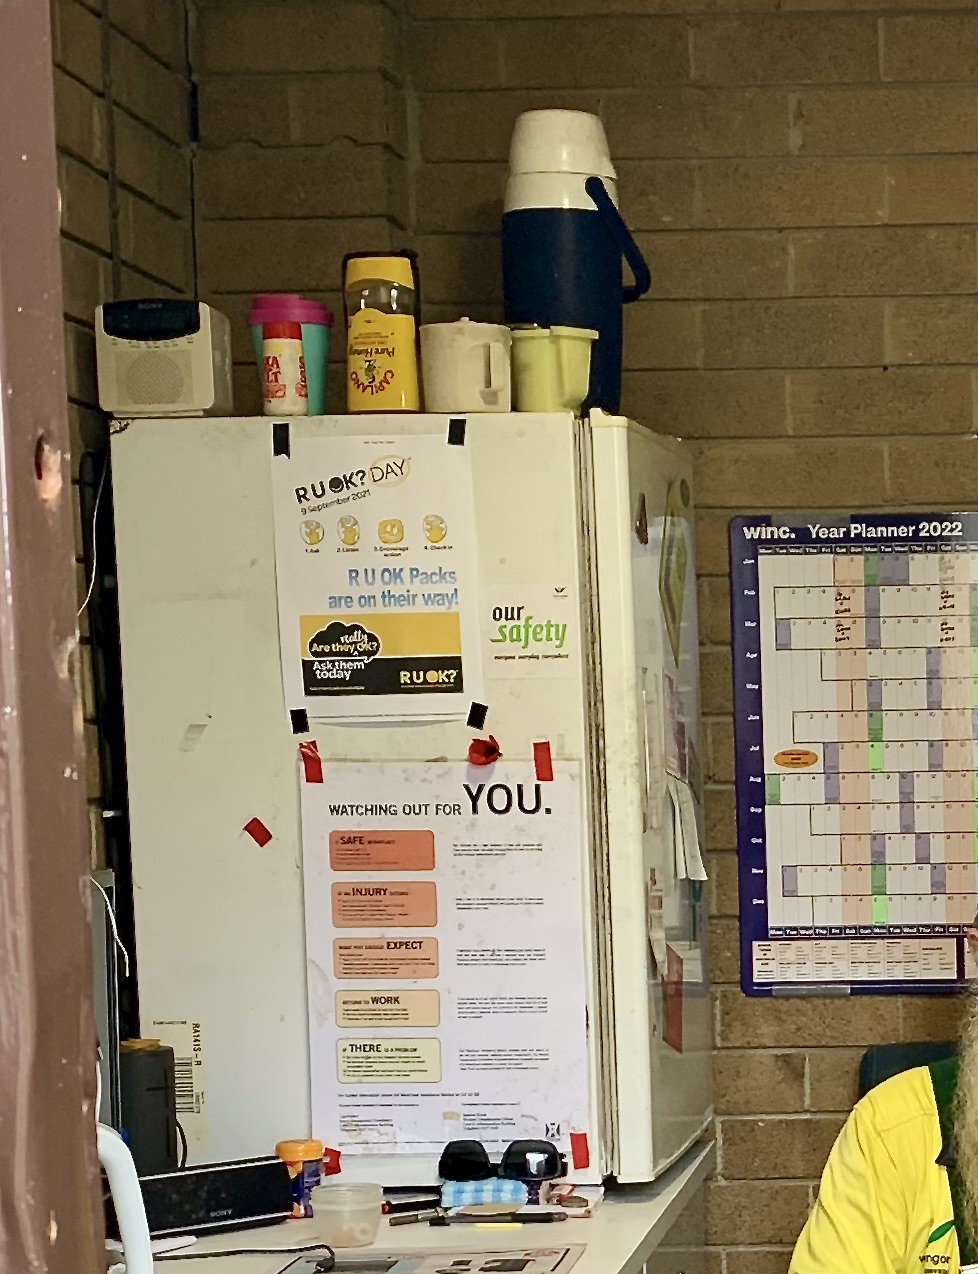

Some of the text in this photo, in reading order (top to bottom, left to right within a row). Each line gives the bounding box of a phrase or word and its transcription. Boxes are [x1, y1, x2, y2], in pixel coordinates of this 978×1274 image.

[350, 368, 395, 396] CAPILANO
[294, 486, 310, 504] R
[310, 481, 326, 499] U
[368, 458, 406, 483] DAY
[301, 489, 371, 516] 9 September 2021
[743, 521, 963, 540] winc. Year Planner 2022
[348, 566, 457, 586] R U OK Packs
[328, 588, 459, 609] are on their way!
[491, 604, 525, 622] our
[340, 629, 368, 645] really
[489, 615, 568, 650] safety
[311, 640, 378, 655] Are they OK?
[313, 660, 365, 671] Ask them
[315, 669, 352, 682] today
[400, 669, 457, 684] R U OK?
[328, 782, 552, 817] WATCHING OUT FOR YOU.
[339, 835, 365, 845] SAFE
[352, 887, 388, 897] INJURY
[386, 940, 424, 950] EXPECT
[370, 996, 401, 1005] WORK
[348, 1043, 382, 1053] THERE
[209, 1208, 233, 1218] SONY
